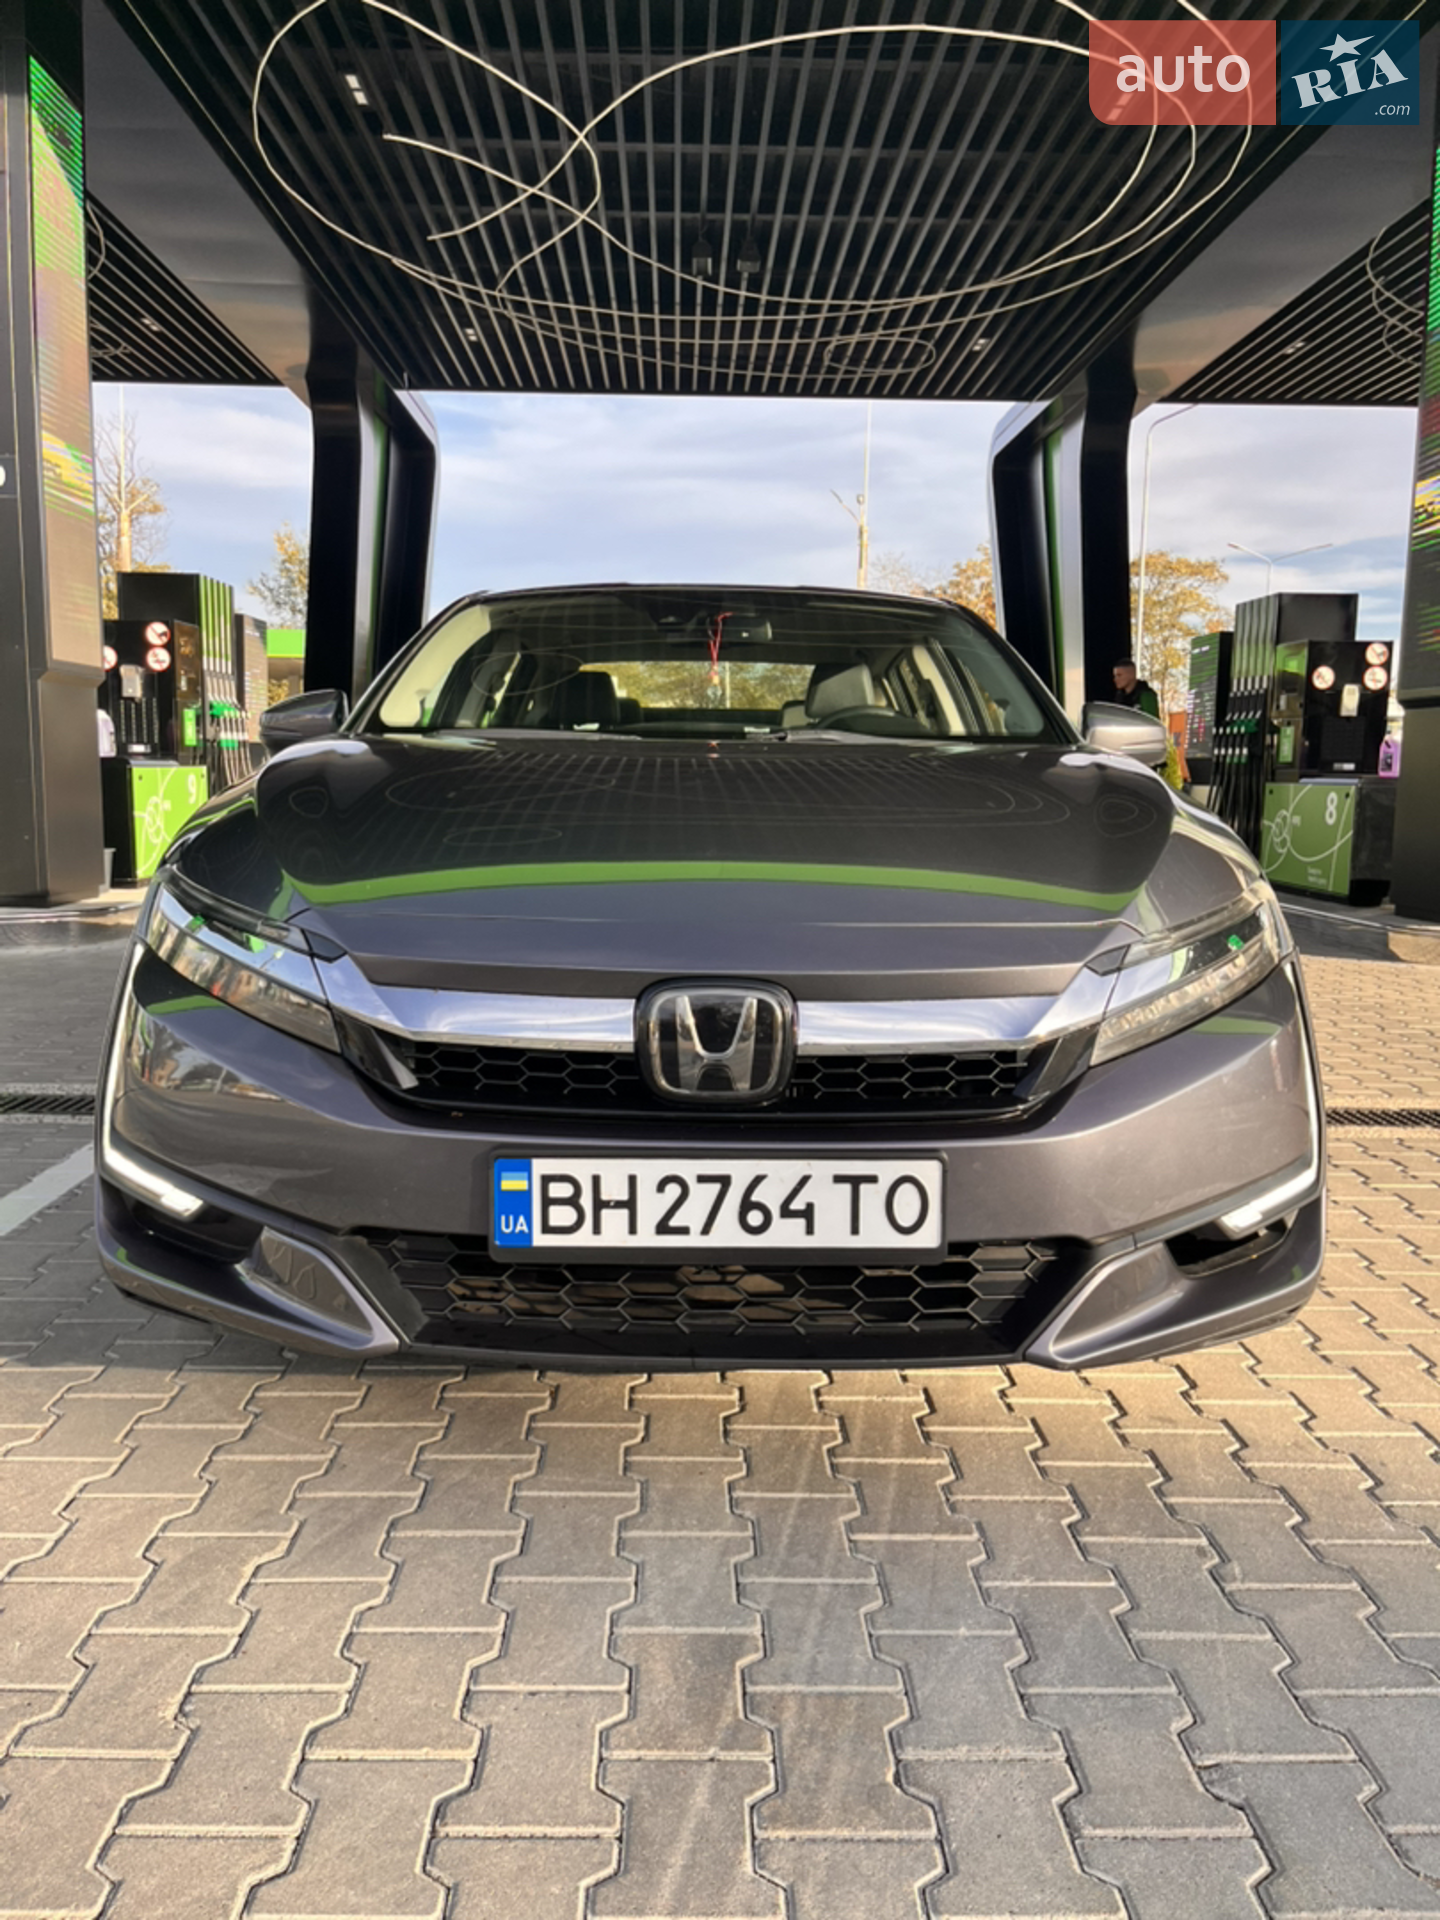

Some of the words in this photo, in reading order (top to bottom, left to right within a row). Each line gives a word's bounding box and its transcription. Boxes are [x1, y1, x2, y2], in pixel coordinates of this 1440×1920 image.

[187, 773, 197, 804] 9
[1325, 791, 1338, 826] 8
[540, 1173, 638, 1236] BH
[655, 1173, 815, 1237] 2764
[832, 1173, 930, 1236] TO
[500, 1215, 529, 1234] UA
